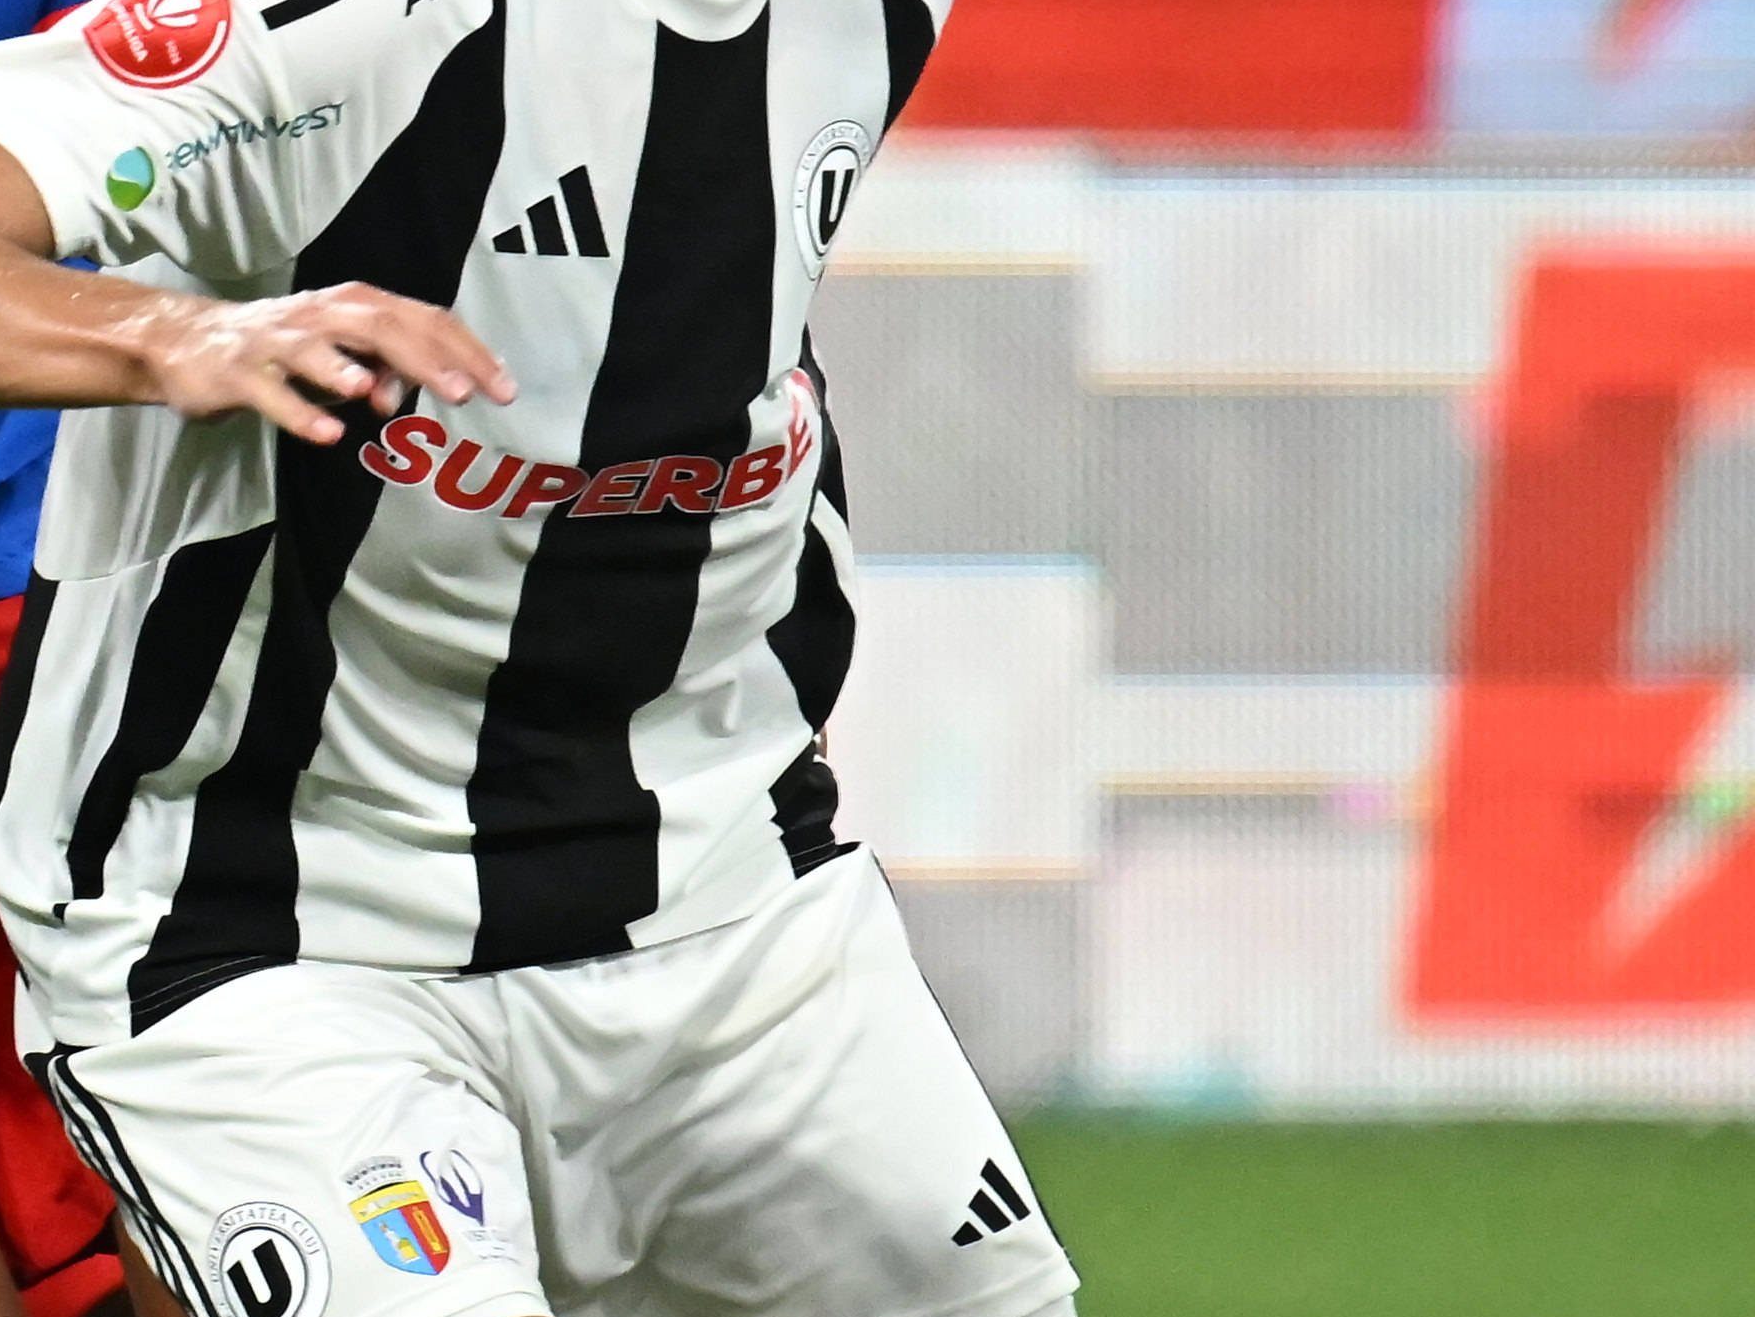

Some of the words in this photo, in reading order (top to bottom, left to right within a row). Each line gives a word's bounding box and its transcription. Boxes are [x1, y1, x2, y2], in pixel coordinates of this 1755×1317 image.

[818, 168, 856, 247] U
[358, 368, 813, 520] SUPERBE
[291, 1218, 322, 1257] CLUJ
